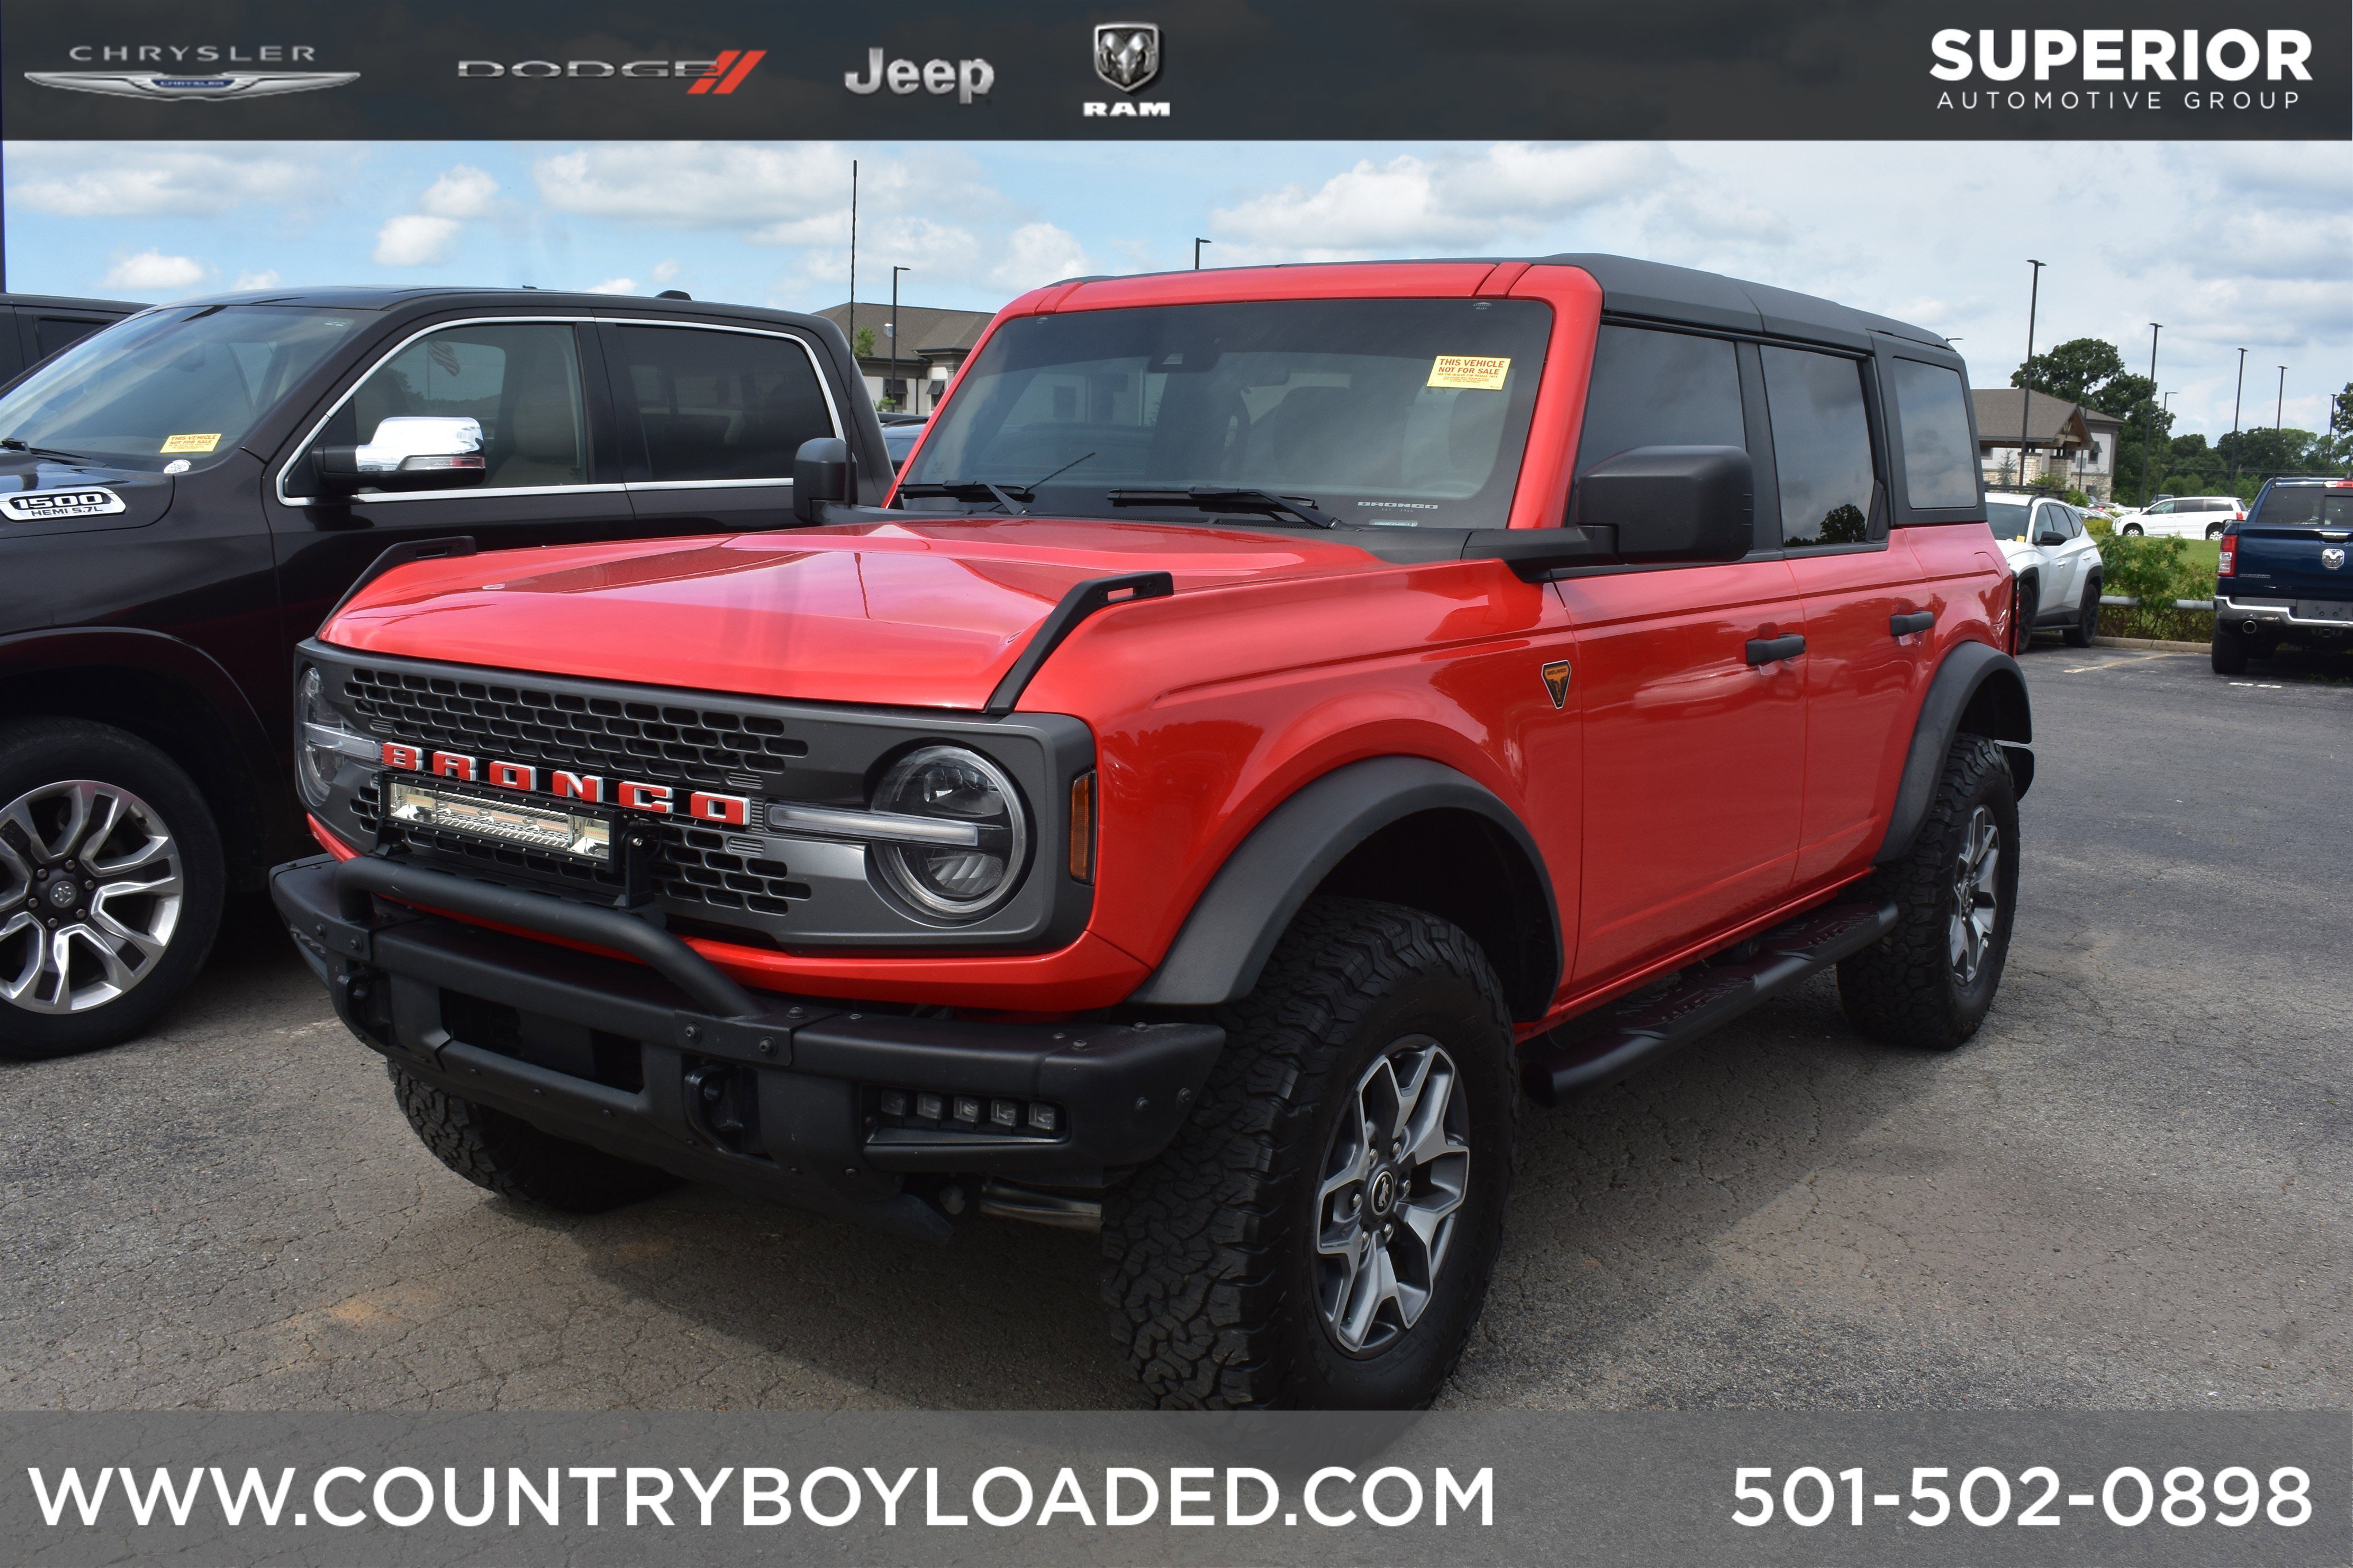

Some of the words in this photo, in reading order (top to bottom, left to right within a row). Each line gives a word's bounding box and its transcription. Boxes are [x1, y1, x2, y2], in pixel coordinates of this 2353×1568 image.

[1440, 358, 1461, 366] THIS
[1464, 359, 1505, 368] VEHICLE
[14, 493, 103, 509] 1500
[1357, 501, 1438, 509] BRONCO
[31, 507, 69, 516] HEMI
[72, 505, 103, 513] 5.7L
[381, 741, 751, 826] BRONCO
